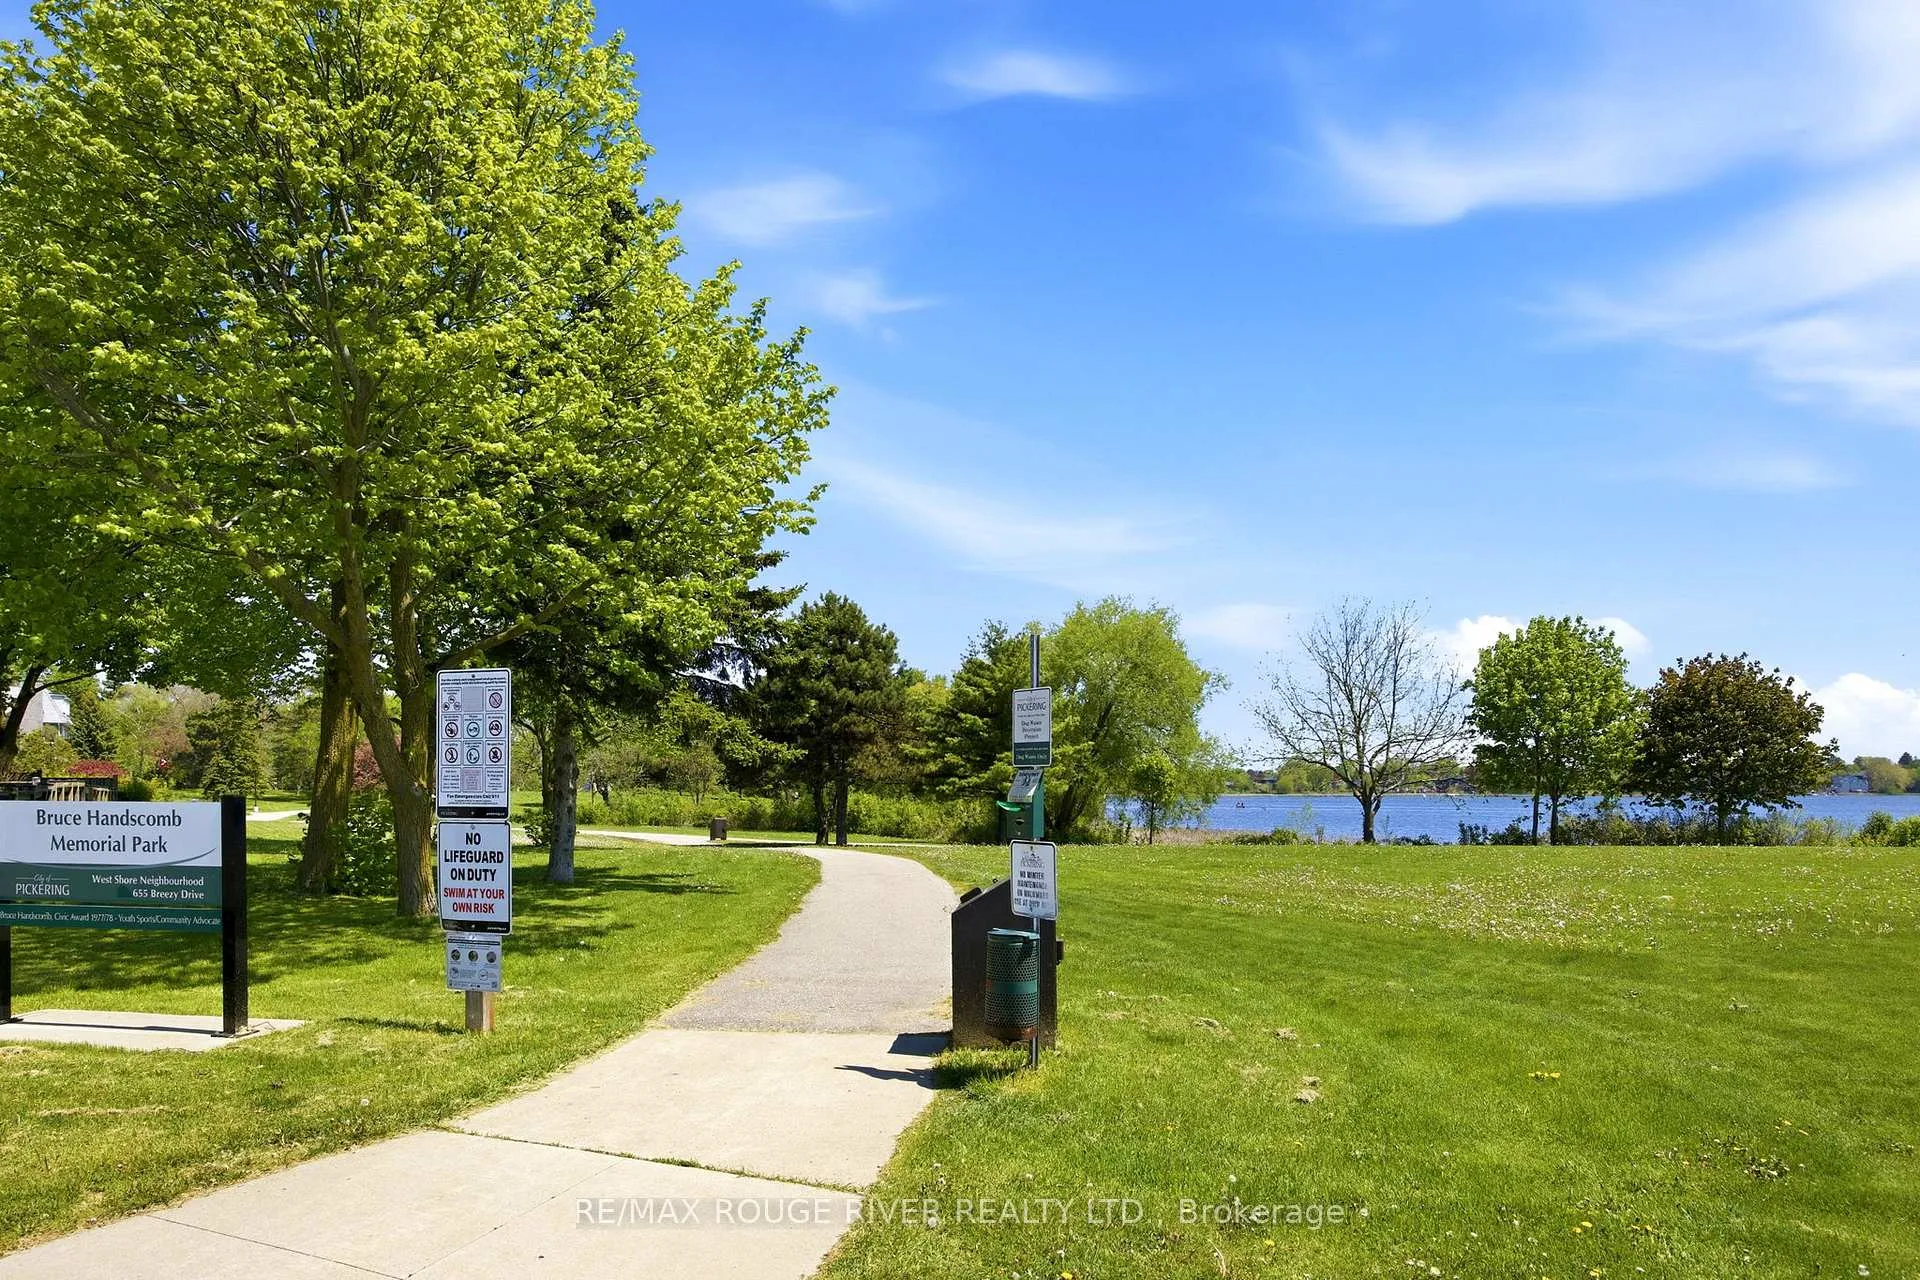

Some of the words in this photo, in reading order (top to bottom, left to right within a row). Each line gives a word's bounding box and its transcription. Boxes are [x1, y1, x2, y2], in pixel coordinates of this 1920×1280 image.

[37, 809, 82, 826] Bruce
[87, 809, 182, 827] Handscomb
[50, 835, 126, 852] Memorial
[132, 835, 168, 853] Park
[465, 832, 481, 846] NO
[444, 850, 504, 864] LIFEGUARD
[92, 874, 112, 885] West
[114, 874, 138, 885] Shore
[140, 876, 204, 887] Neighbourhood
[450, 868, 465, 881] ON
[468, 868, 497, 882] DUTY
[15, 883, 70, 896] PICKERING
[132, 889, 148, 898] 655
[150, 889, 179, 900] Breezy
[181, 890, 204, 900] Drive
[443, 887, 465, 898] SWIM
[467, 888, 478, 899] AT
[481, 888, 505, 900] YOUR
[452, 902, 471, 913] OWN
[474, 902, 495, 914] RISK
